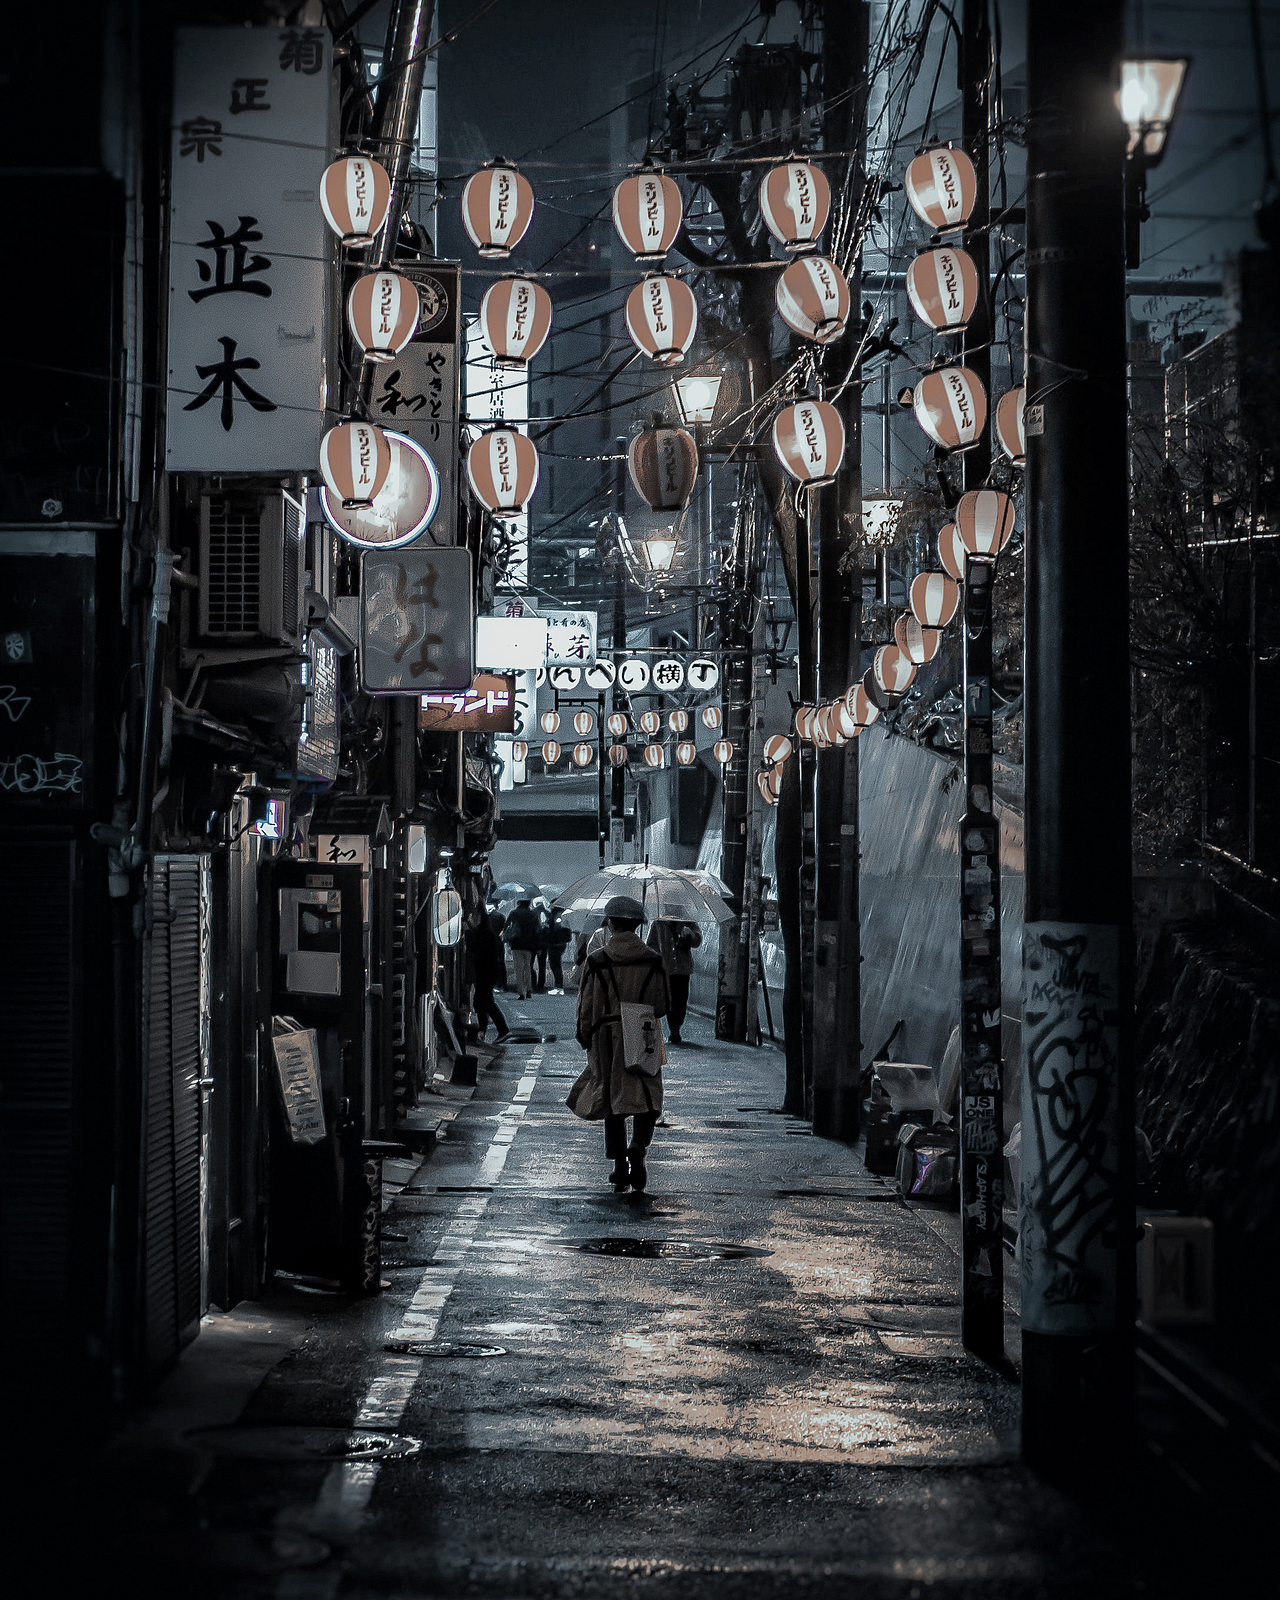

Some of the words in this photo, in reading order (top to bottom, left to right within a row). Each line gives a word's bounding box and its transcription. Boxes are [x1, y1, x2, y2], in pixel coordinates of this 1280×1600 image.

[353, 161, 368, 218] キリンビール
[494, 174, 511, 230] キリンビール
[645, 181, 660, 237] キリンビール
[794, 168, 812, 225] キリンビール
[938, 155, 960, 210] キリンビール
[378, 278, 394, 334] キリンビール
[649, 281, 667, 334] キリンビール
[941, 254, 961, 311] キリンビール
[182, 215, 278, 432] 並木
[512, 286, 529, 341] キリンビール
[426, 352, 446, 442] やきとり
[949, 374, 973, 430] キリンビール
[357, 428, 371, 485] キリンビール
[801, 408, 823, 464] キリンビール
[496, 437, 513, 493] キリンビール
[537, 662, 716, 685] んべい横丁
[966, 1109, 994, 1118] ONE
[969, 1097, 991, 1109] JS
